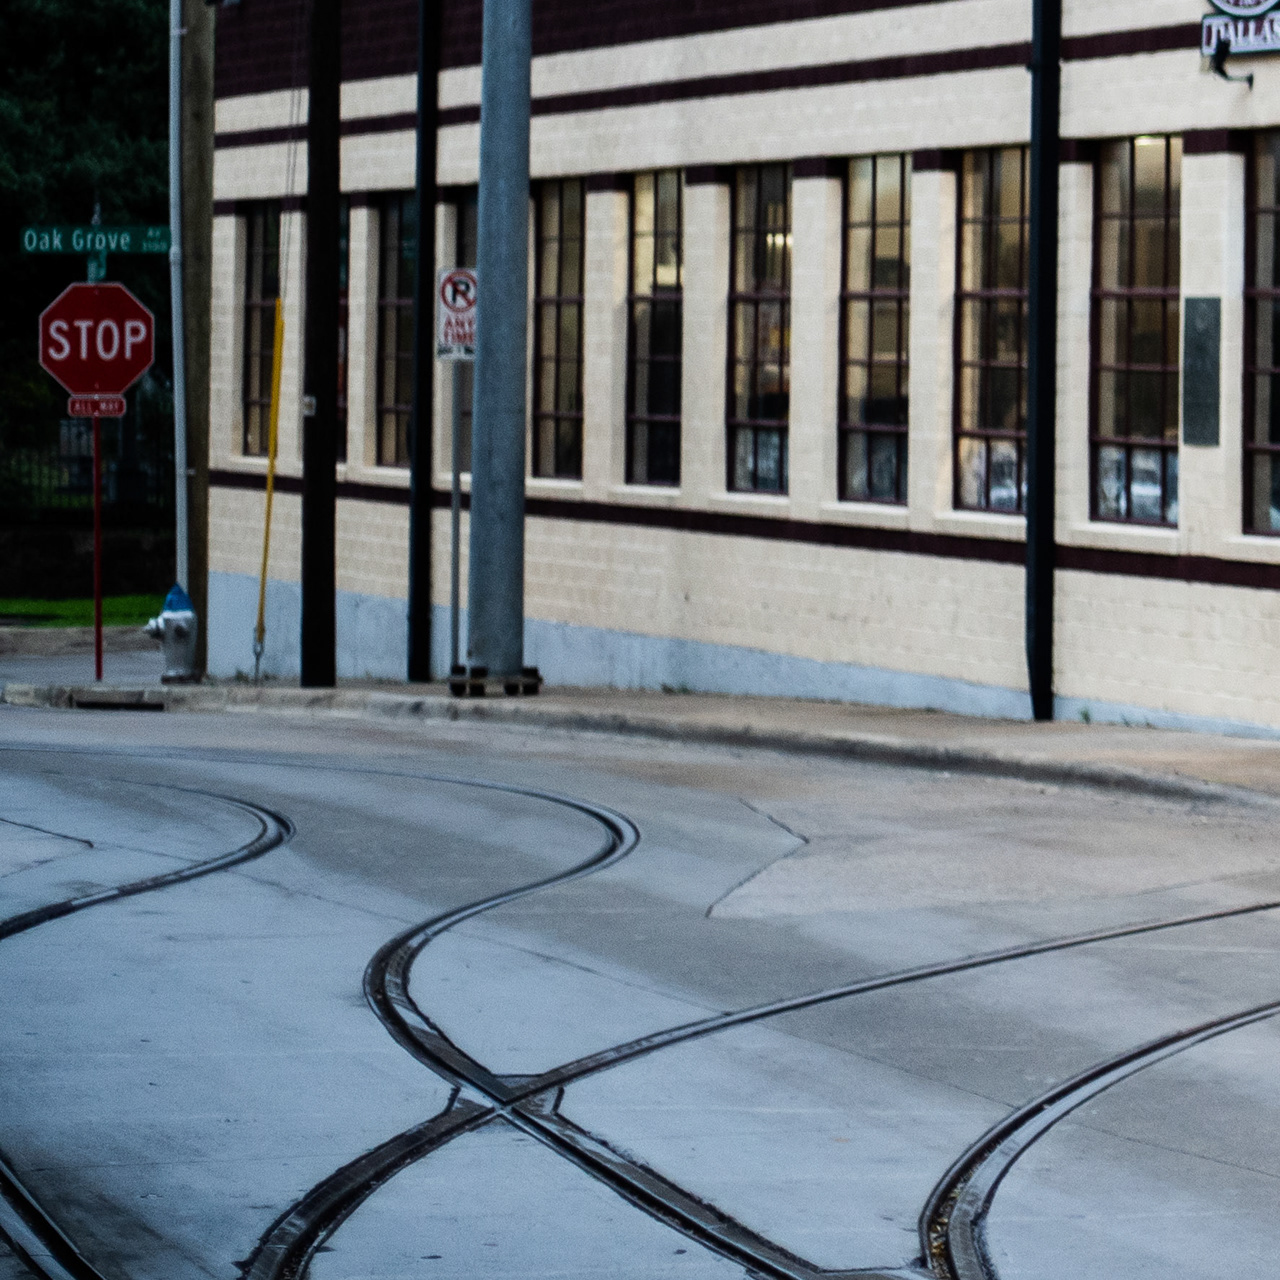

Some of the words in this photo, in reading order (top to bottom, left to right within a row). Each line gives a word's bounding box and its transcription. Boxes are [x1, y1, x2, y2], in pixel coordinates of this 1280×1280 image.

[24, 227, 63, 252] Oak
[72, 227, 131, 252] Grove
[47, 318, 148, 361] STOP
